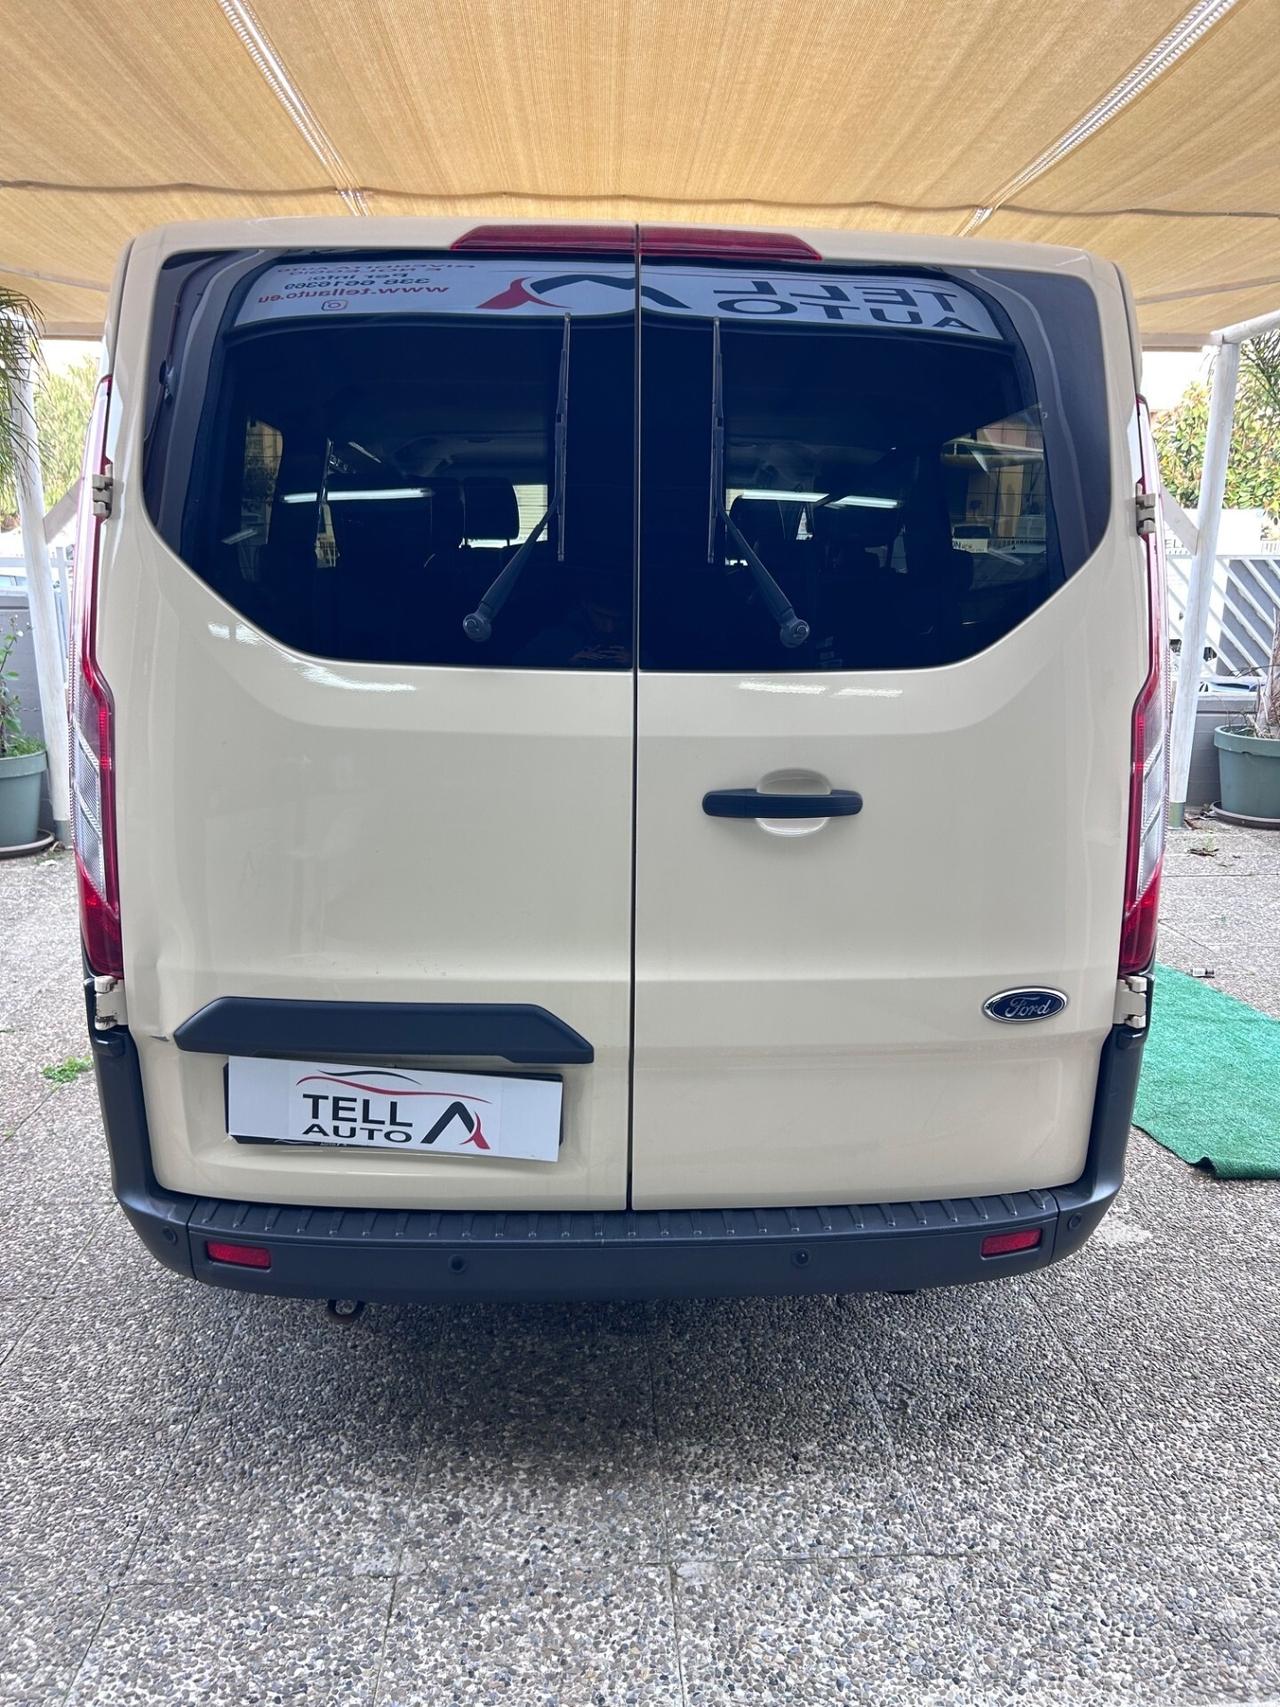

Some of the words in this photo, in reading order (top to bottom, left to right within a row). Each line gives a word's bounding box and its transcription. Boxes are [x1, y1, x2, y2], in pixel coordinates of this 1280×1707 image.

[1004, 996, 1052, 1018] Ford
[303, 1094, 413, 1127] TELL
[303, 1123, 412, 1143] AUTO
